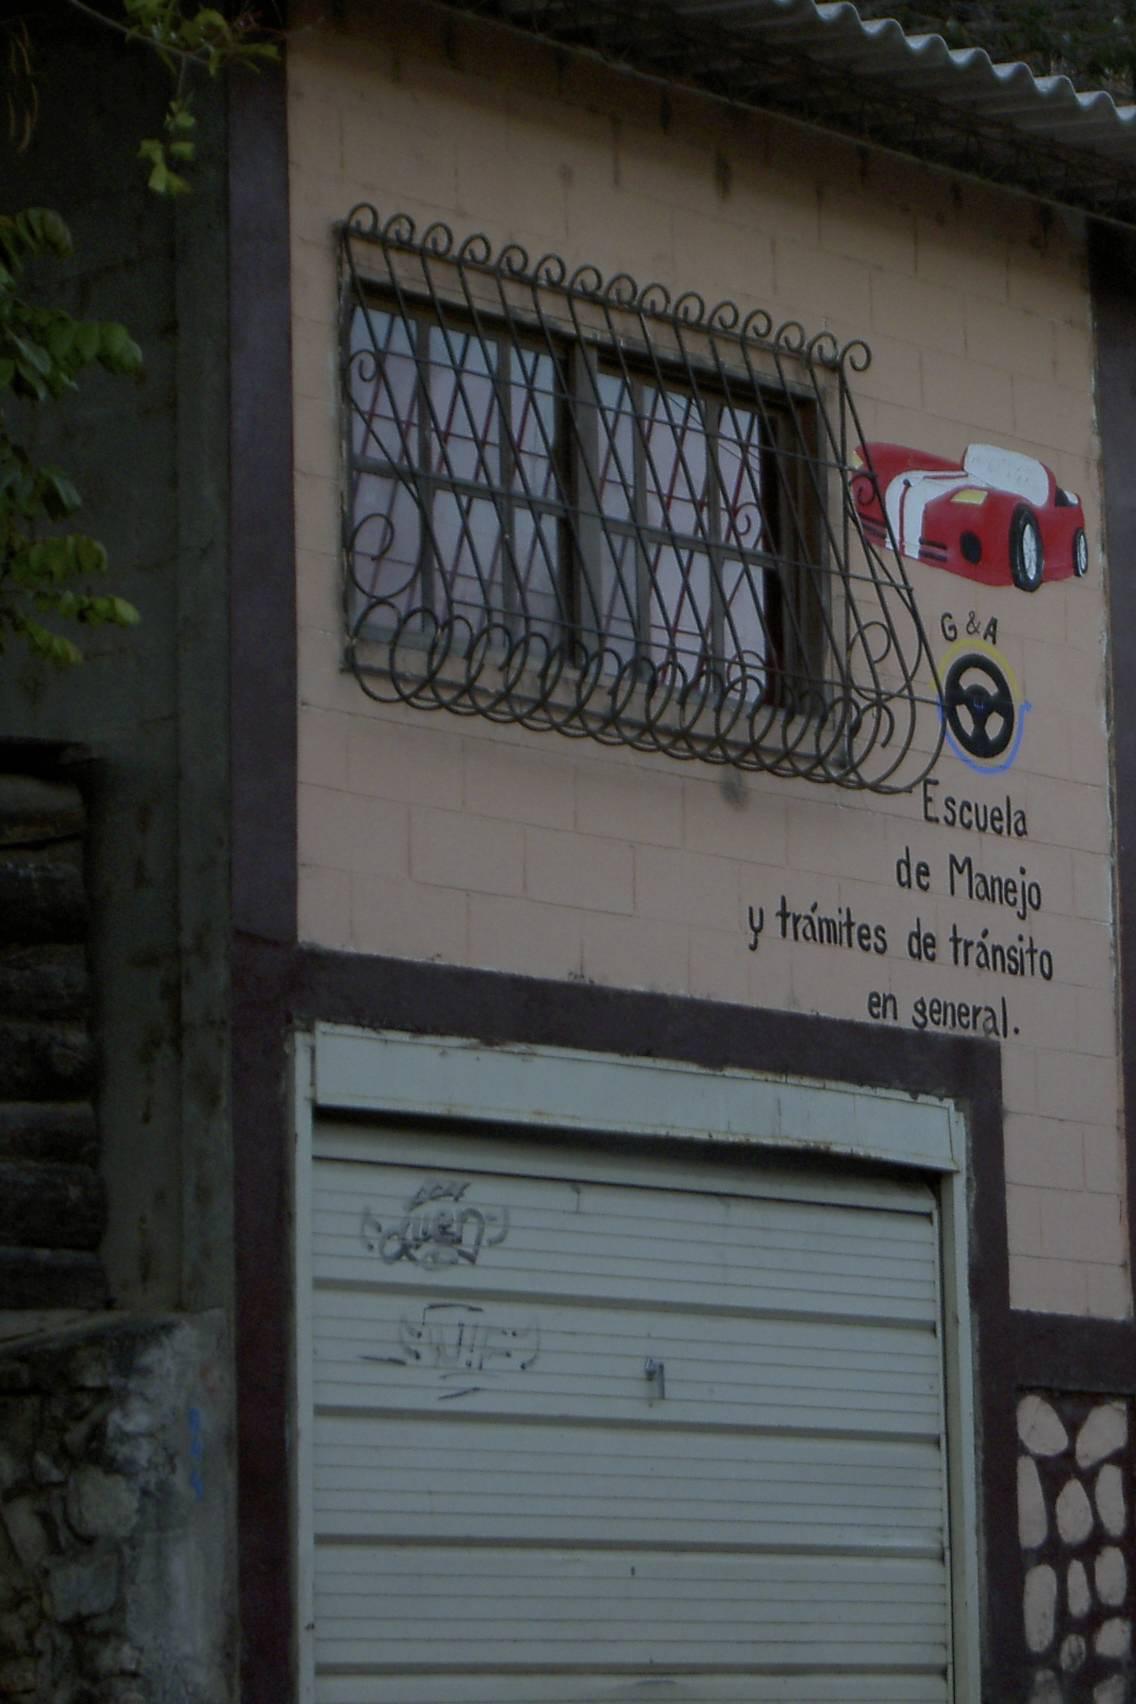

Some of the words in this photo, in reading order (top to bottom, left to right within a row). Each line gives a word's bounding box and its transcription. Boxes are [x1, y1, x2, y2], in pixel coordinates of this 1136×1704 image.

[922, 779, 1028, 838] Escuela
[896, 846, 930, 892] de
[949, 853, 1042, 921] Manejo
[748, 905, 764, 951] y
[776, 896, 888, 955] trámites
[908, 917, 937, 963] de
[950, 924, 1054, 981] tránsito
[868, 990, 898, 1020] en
[912, 996, 1021, 1039] general.
